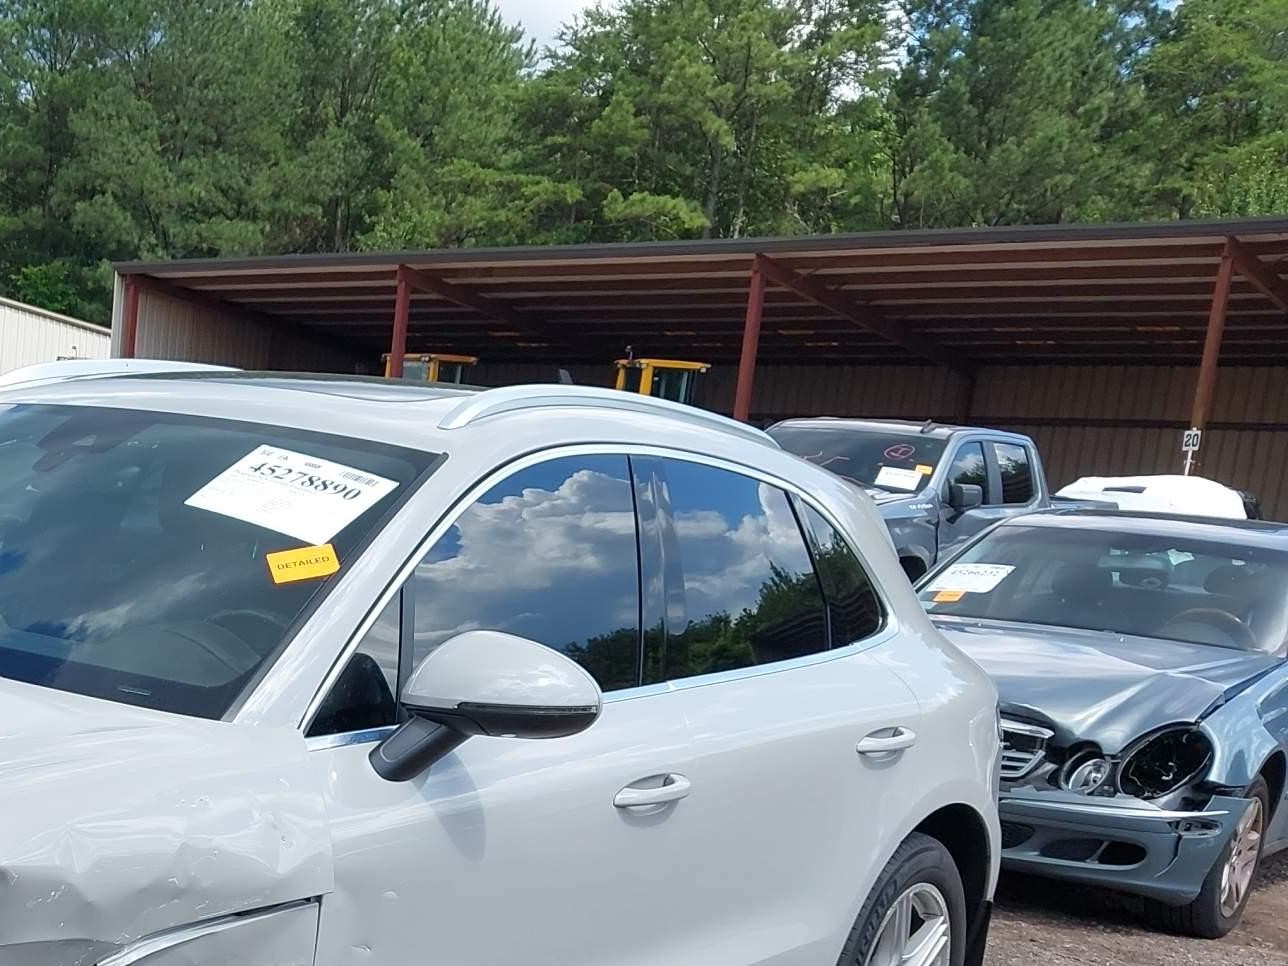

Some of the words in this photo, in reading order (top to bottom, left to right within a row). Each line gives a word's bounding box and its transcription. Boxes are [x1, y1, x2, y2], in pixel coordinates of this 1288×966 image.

[1184, 433, 1200, 448] 20
[248, 461, 362, 501] 45278890
[276, 556, 331, 570] DETAILED
